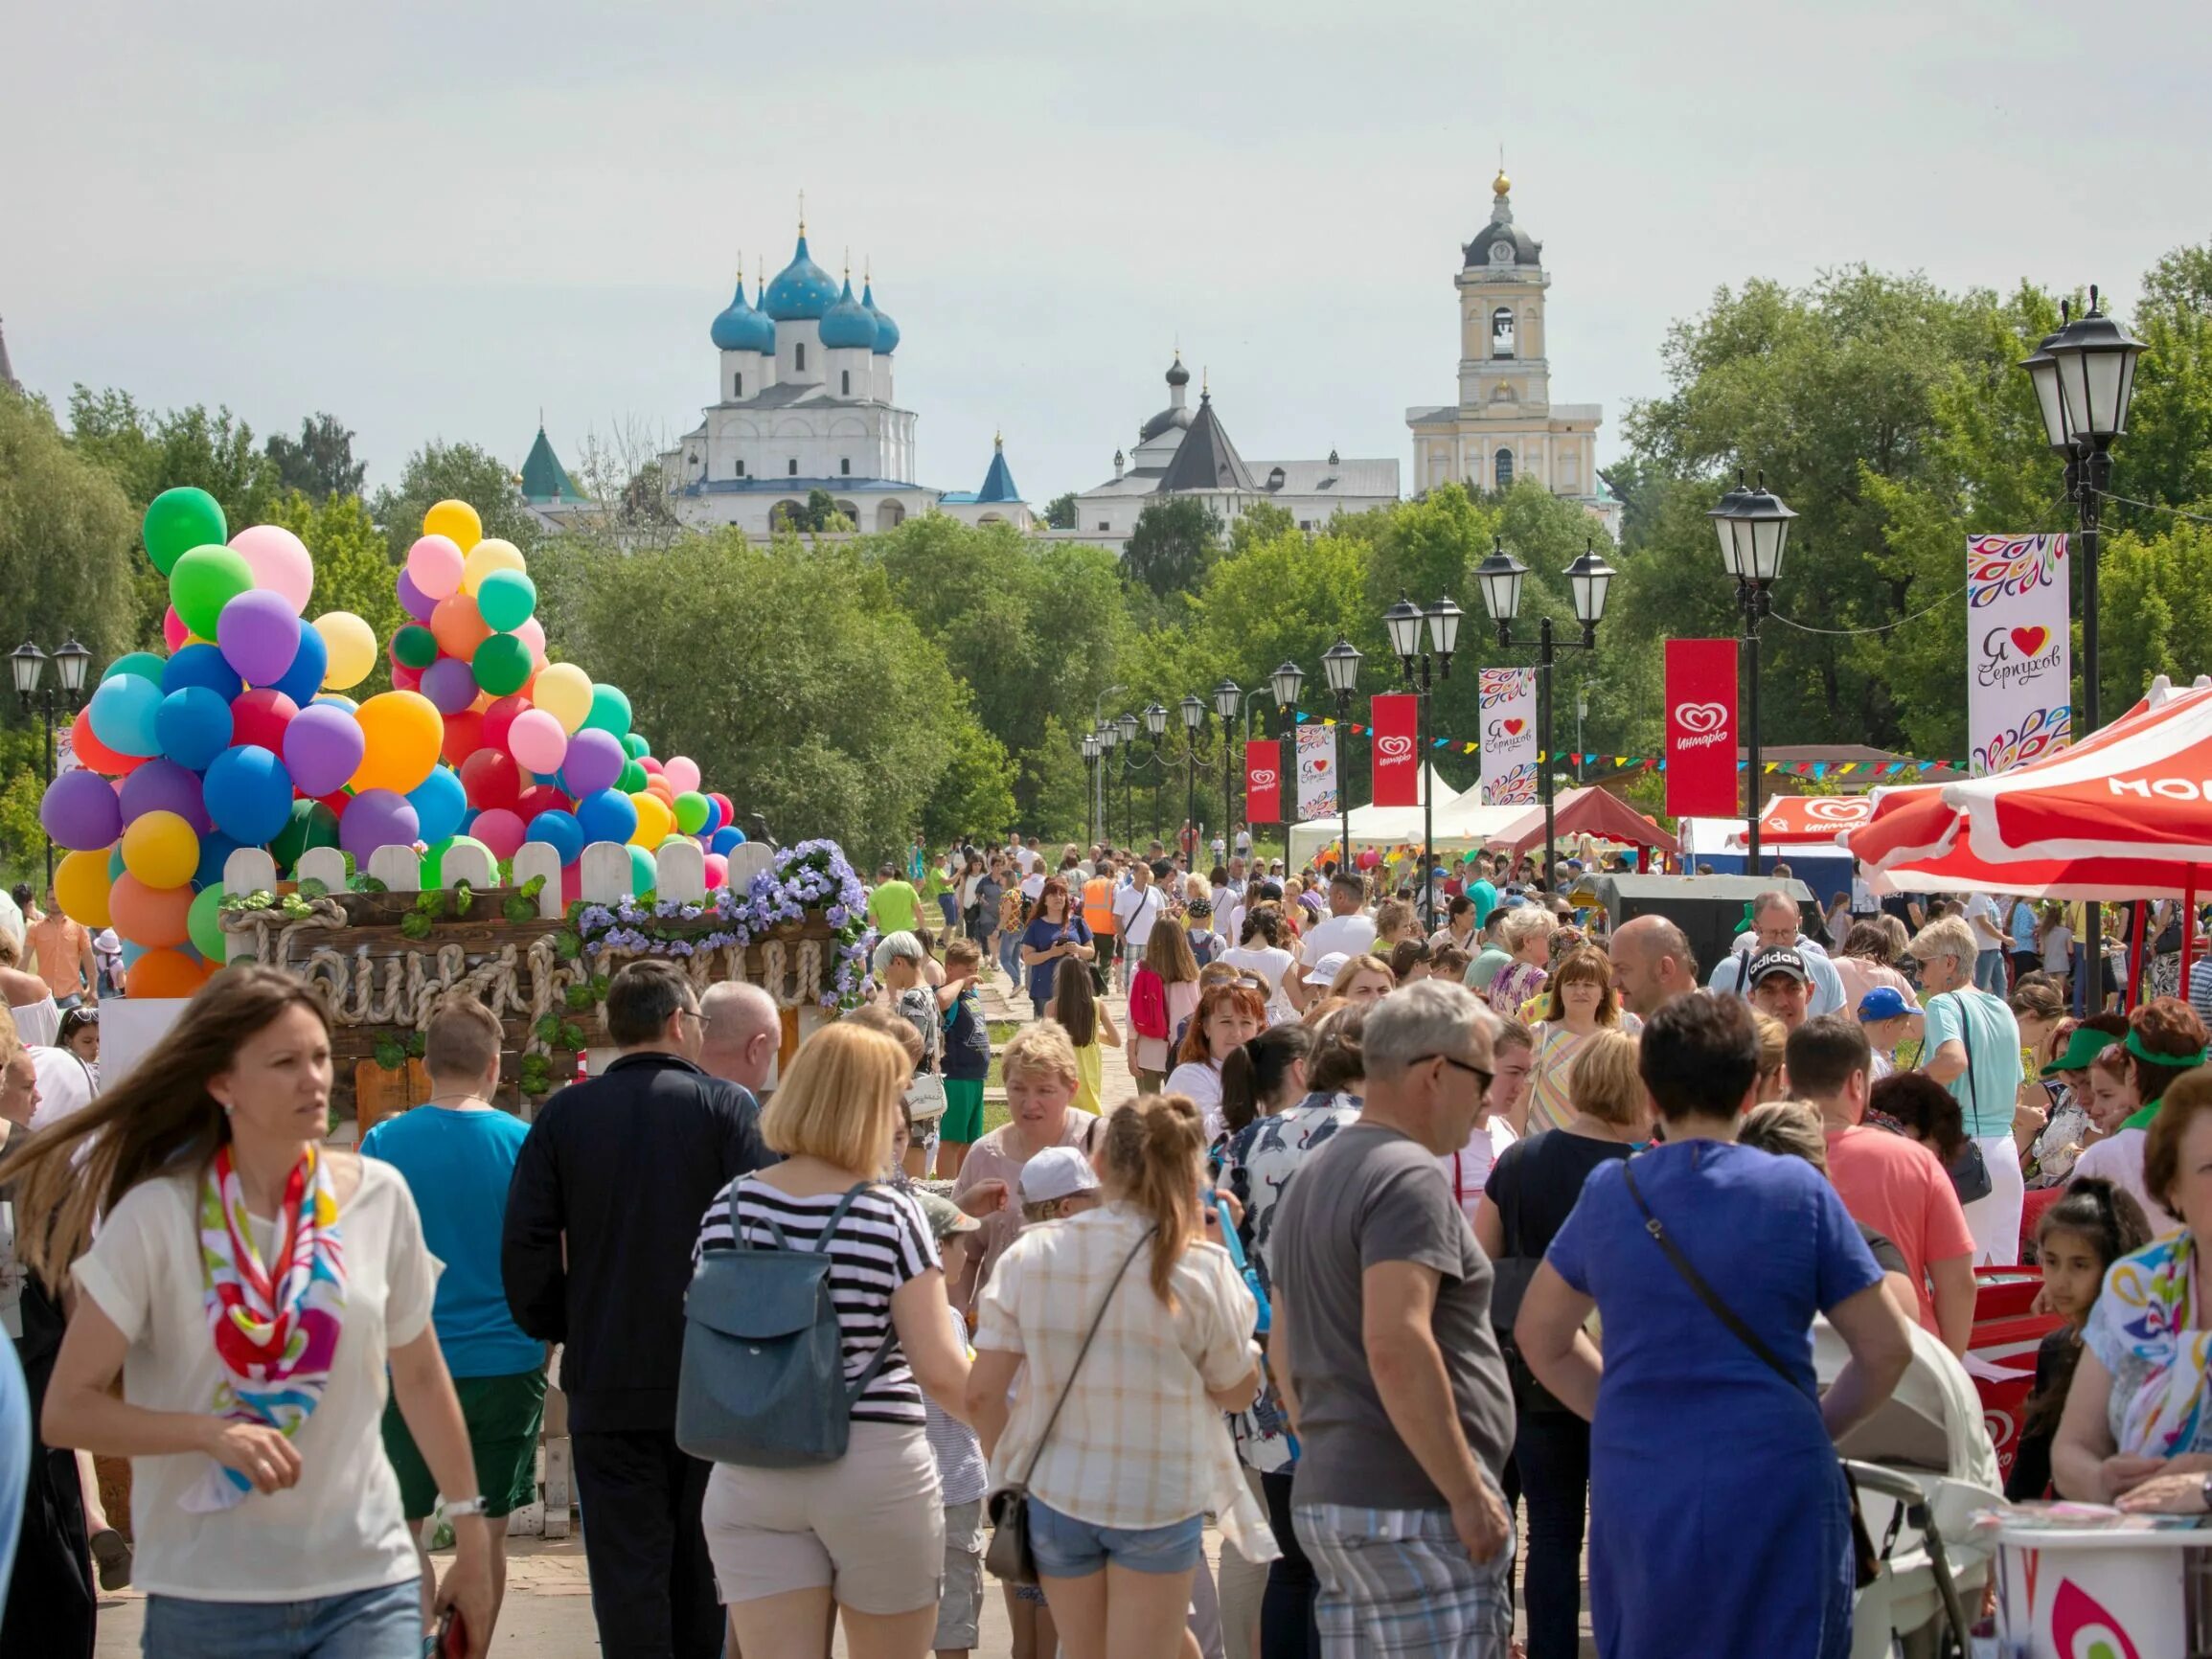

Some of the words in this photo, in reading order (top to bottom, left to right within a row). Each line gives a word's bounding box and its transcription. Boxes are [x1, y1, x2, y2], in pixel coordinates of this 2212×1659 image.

[1982, 626, 2009, 662] Я
[1977, 645, 2061, 690] Серпухов
[1488, 718, 1502, 739] Я
[2107, 777, 2212, 803] МО
[1804, 819, 1869, 832] Инмар
[1749, 951, 1801, 975] adidas
